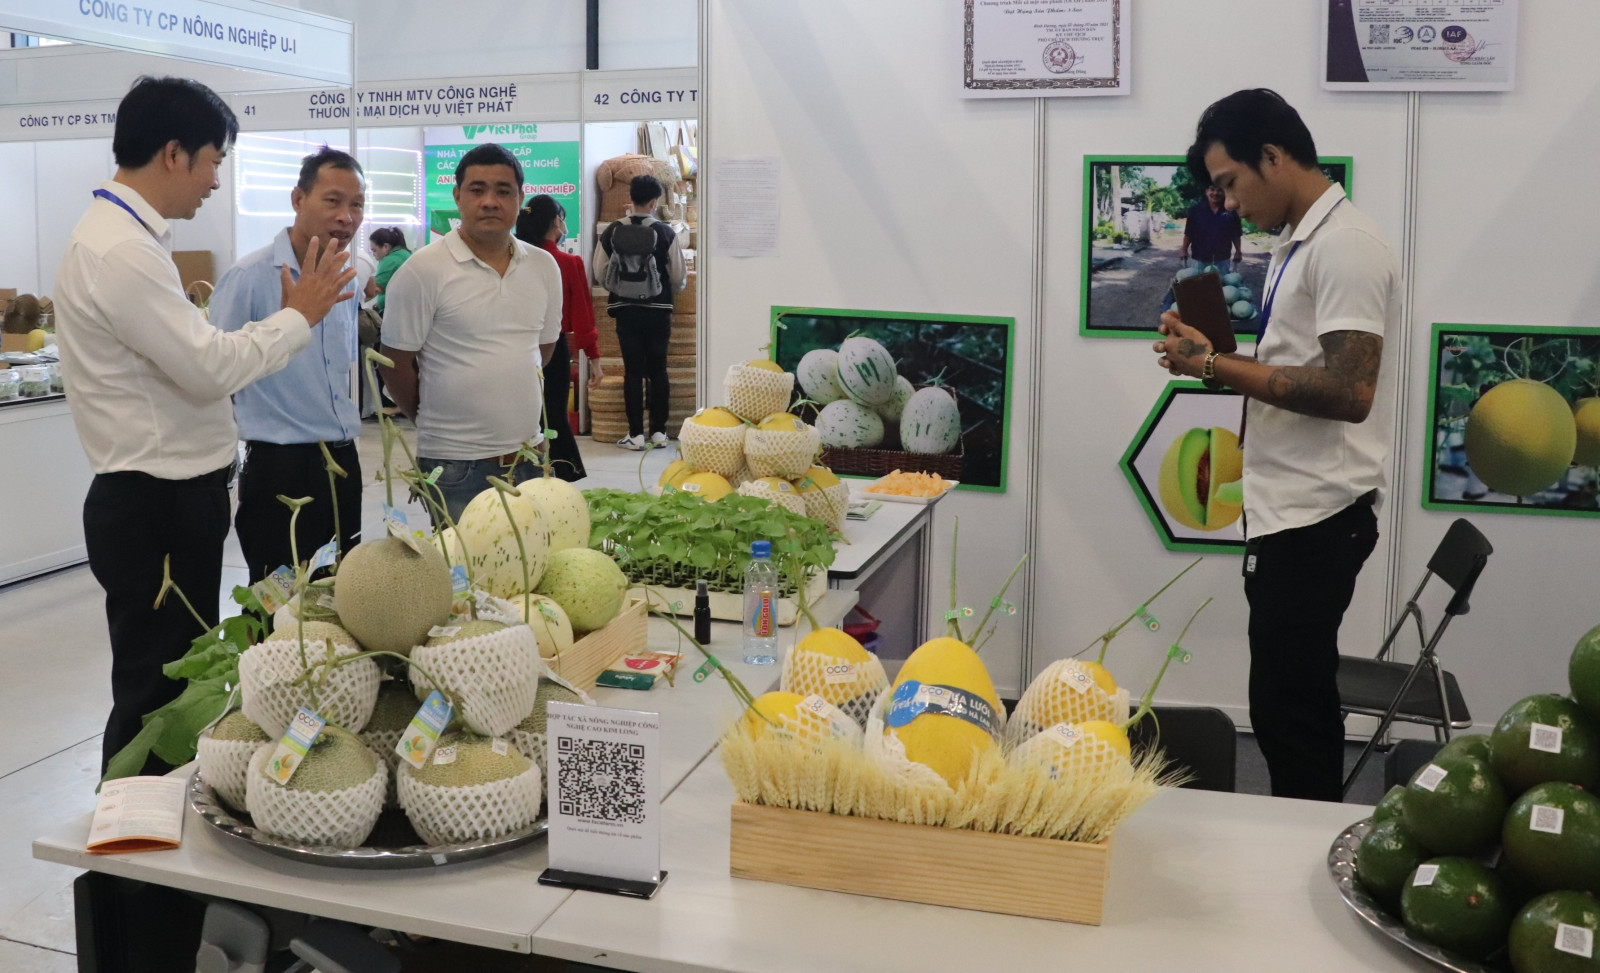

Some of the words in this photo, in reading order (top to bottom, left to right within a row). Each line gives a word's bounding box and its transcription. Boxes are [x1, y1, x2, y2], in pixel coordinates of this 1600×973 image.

[133, 7, 153, 27] TY
[158, 12, 178, 31] CP
[183, 15, 224, 40] NÔNG
[228, 26, 277, 51] NGHIỆP
[280, 36, 296, 54] U-I
[1446, 30, 1461, 38] IAF
[310, 91, 345, 105] CÔNG
[369, 91, 403, 102] TNHH
[407, 89, 433, 101] MTV
[437, 86, 474, 99] CÔNG
[479, 83, 517, 99] NGHỆ
[594, 94, 609, 105] 42
[620, 88, 662, 104] CÔNG
[667, 90, 684, 102] TY
[244, 105, 256, 116] 41
[364, 105, 386, 118] MẠI
[389, 104, 420, 118] DỊCH
[424, 103, 441, 117] VỤ
[445, 100, 473, 117] VIỆT
[478, 97, 513, 113] PHÁT
[20, 115, 48, 127] CÔNG
[52, 116, 64, 126] TY
[67, 115, 81, 125] CP
[84, 114, 98, 125] SX
[437, 148, 457, 159] NHÀ
[513, 146, 532, 157] CẤP
[437, 160, 455, 170] CÁC
[533, 157, 560, 169] NGHỆ
[437, 175, 451, 184] AN
[539, 183, 576, 196] NGHIỆP
[920, 686, 949, 696] OCOP
[299, 712, 320, 728] OCOP
[619, 728, 639, 736] LONG
